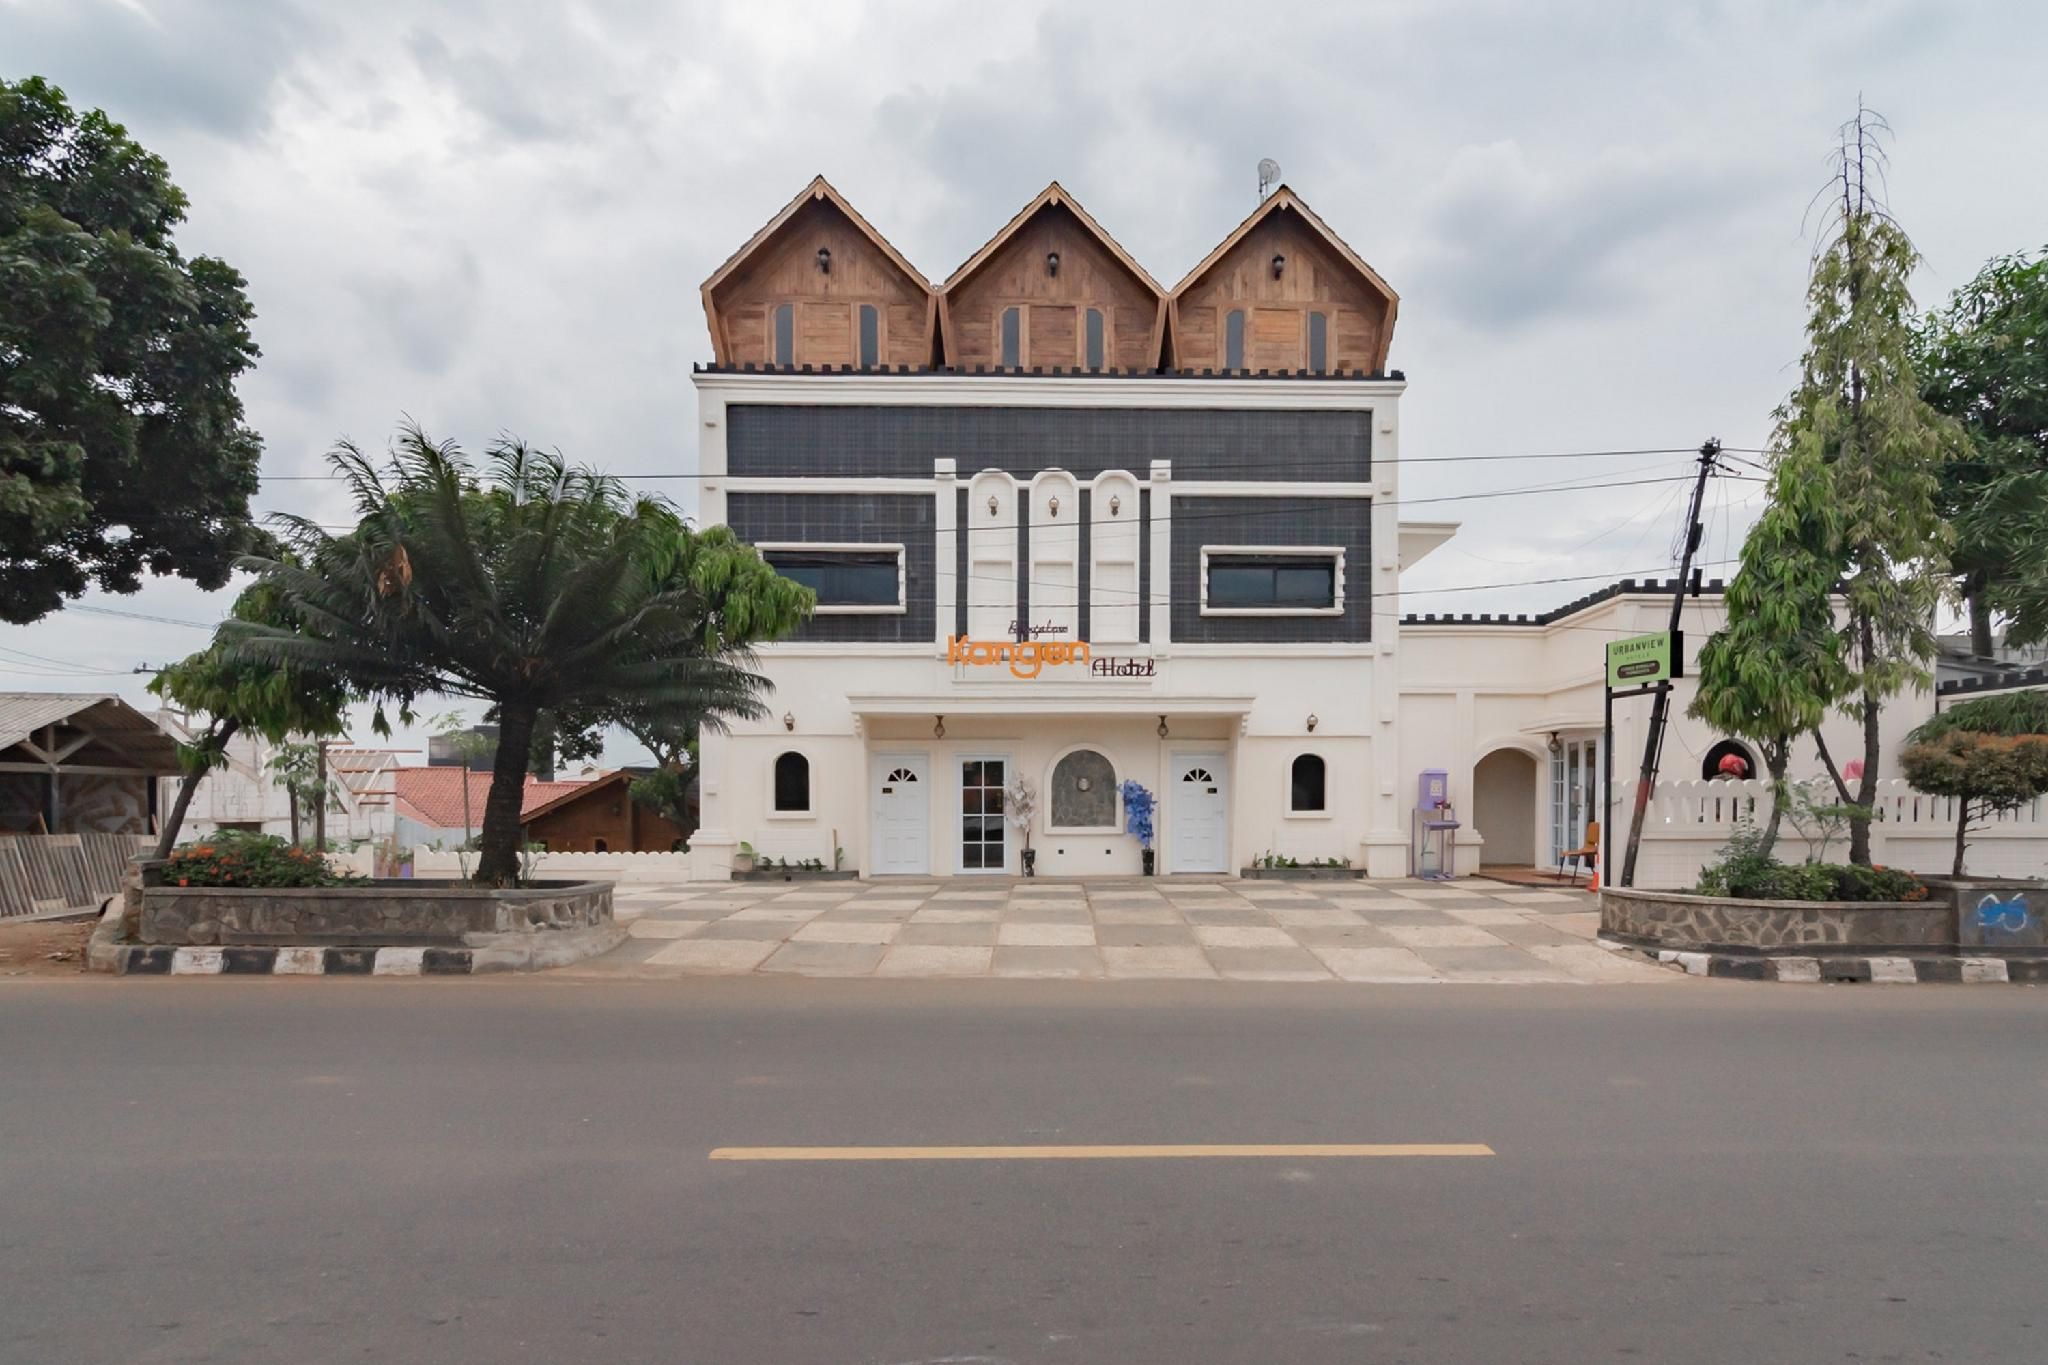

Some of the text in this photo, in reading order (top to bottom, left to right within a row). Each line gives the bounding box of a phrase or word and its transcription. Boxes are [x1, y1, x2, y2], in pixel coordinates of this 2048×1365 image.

[1008, 619, 1068, 640] Bgalow
[947, 633, 1157, 679] Kangen Hotel
[1613, 638, 1664, 655] URBANVIEW
